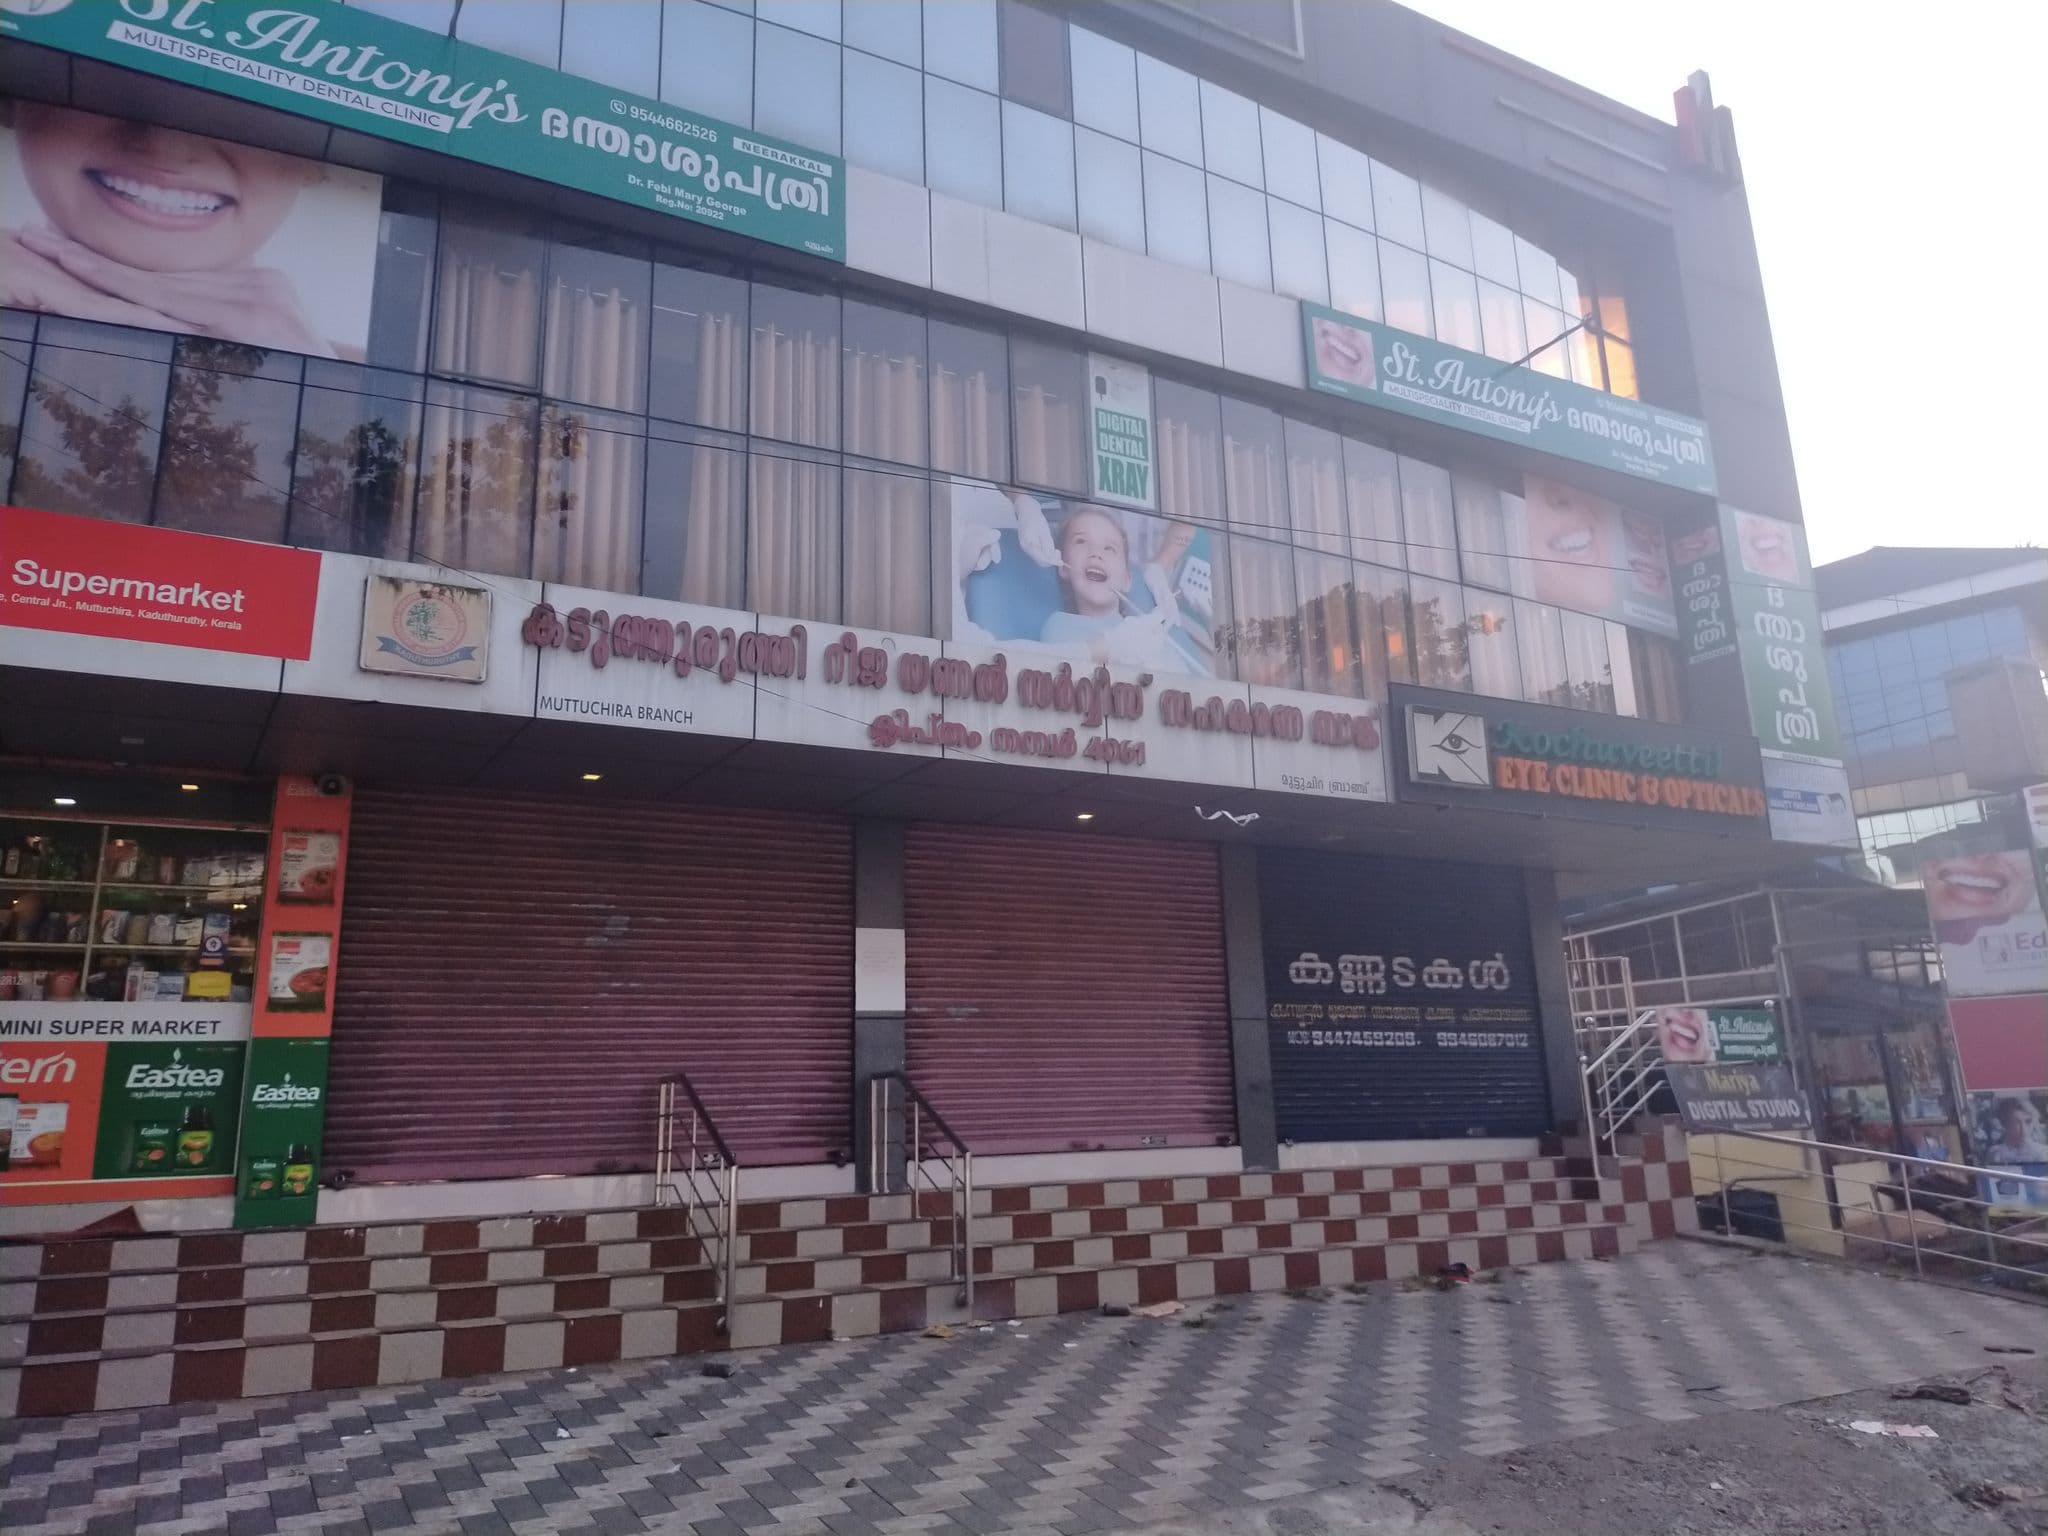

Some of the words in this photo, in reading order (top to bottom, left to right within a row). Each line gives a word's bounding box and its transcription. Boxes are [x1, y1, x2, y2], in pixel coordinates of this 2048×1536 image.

[124, 27, 298, 87] MULTISPECIALITY
[302, 78, 376, 111] DENTAL
[379, 100, 441, 128] CLINIC
[225, 9, 529, 129] Antony's
[629, 105, 718, 143] 9544662526
[541, 107, 829, 217] ദന്താശുപത്രി
[741, 140, 826, 174] NEERAKKAL
[627, 174, 644, 188] Dr.
[674, 186, 703, 204] Mary
[705, 196, 747, 216] George
[1382, 342, 1424, 386] St.
[1428, 358, 1563, 431] Antony's
[1099, 411, 1145, 438] DIGITAL
[1100, 432, 1145, 459] DENTAL
[1098, 454, 1149, 500] XRAY
[11, 558, 245, 613] Supermarket
[11, 593, 50, 606] Central
[75, 601, 135, 618] Muttuchira,
[137, 608, 208, 629] Kaduthuruthy,
[211, 618, 242, 631] Kerala
[522, 602, 807, 682] കടുത്തുരുത്തി
[539, 696, 633, 718] MUTTUCHIRA
[637, 705, 694, 725] BRANCH
[1082, 735, 1146, 766] 4061
[1496, 756, 1550, 792] EYE
[1554, 764, 1637, 802] CLINIC
[1640, 775, 1660, 805] &
[1662, 778, 1766, 817] OPTICALS
[0, 1019, 42, 1035] MINI
[49, 1020, 124, 1035] SUPER
[131, 1020, 221, 1035] MARKET
[0, 1050, 77, 1084] ern
[125, 1064, 224, 1088] Eastea
[252, 1084, 320, 1102] Eastea
[1688, 1100, 1748, 1120] DIGITAL
[1748, 1099, 1801, 1118] STUDIO
